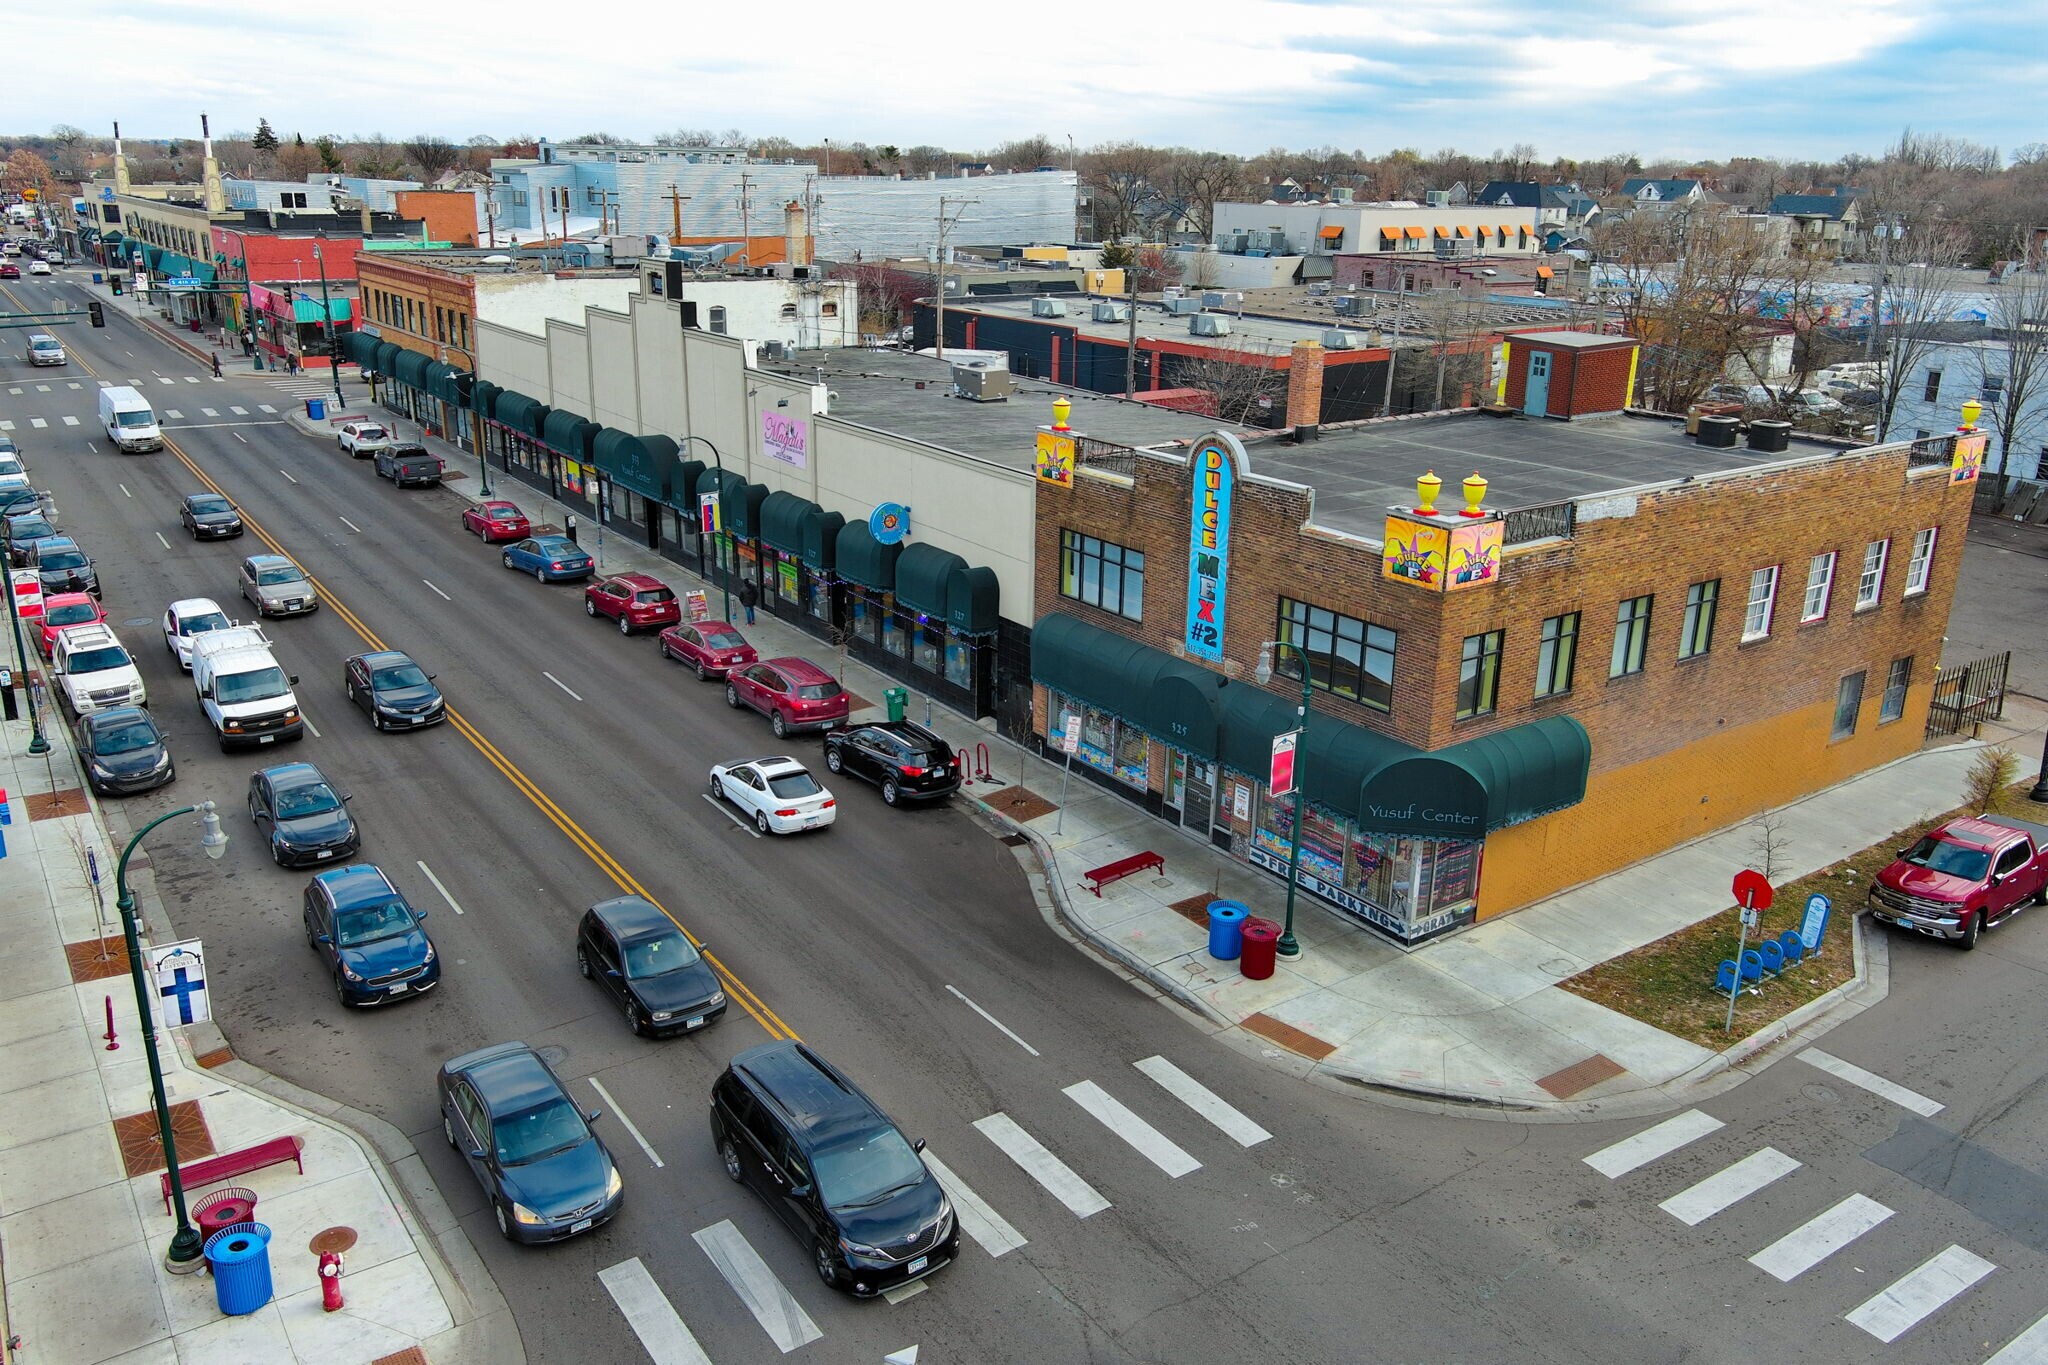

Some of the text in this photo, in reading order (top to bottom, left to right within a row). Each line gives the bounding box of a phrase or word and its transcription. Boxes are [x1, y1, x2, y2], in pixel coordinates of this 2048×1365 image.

[1042, 468, 1067, 482] MEX
[1955, 469, 1975, 481] MEX
[1197, 449, 1222, 623] DULCE MEX
[1396, 551, 1431, 572] DULCE
[1461, 553, 1491, 572] DULCE
[1392, 563, 1432, 583] MEX
[1456, 566, 1491, 584] MEX
[1191, 622, 1218, 648] #2
[1171, 721, 1188, 736] 325
[1369, 803, 1479, 825] Yusuf Center
[1317, 881, 1389, 927] PARKING
